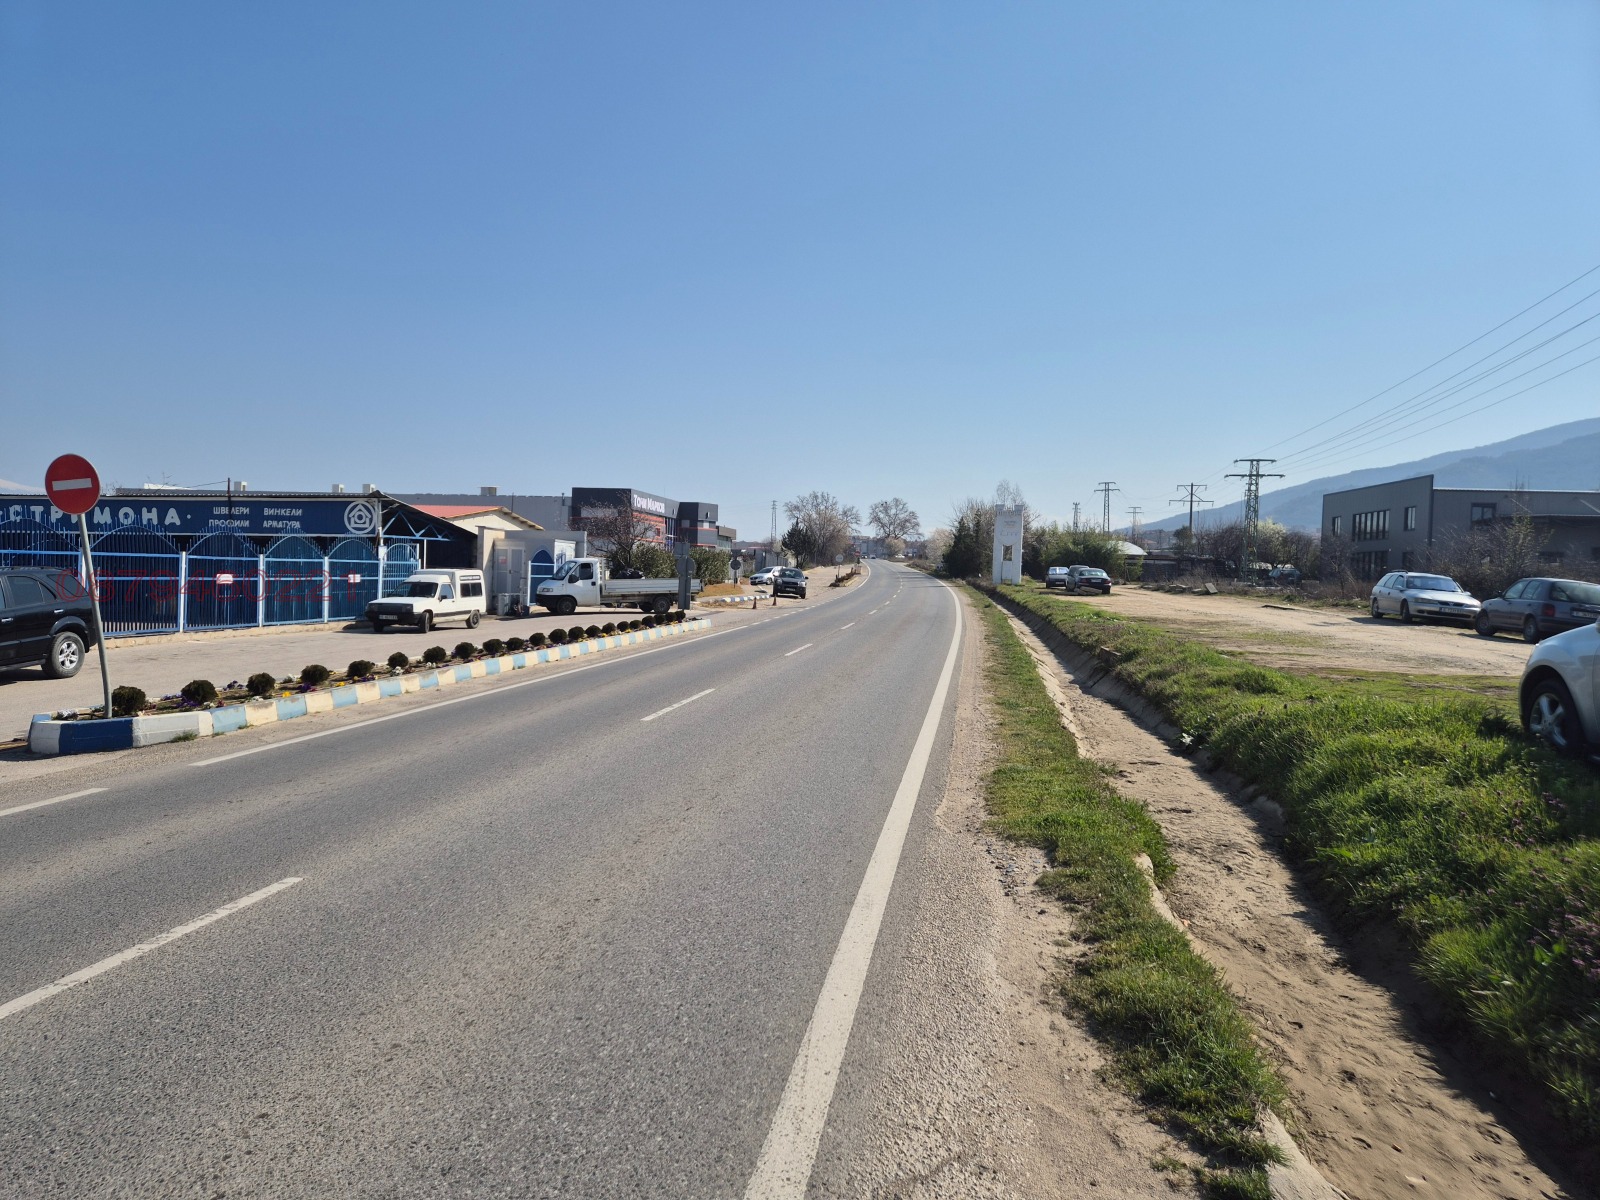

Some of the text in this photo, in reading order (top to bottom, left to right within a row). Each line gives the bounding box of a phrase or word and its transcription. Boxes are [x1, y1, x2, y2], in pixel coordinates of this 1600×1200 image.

[9, 504, 181, 526] СТРМОНА
[213, 506, 250, 515] ШВЕЛЕРИ
[263, 507, 303, 516] ВИНКЕЛИ
[208, 519, 250, 528] ПРОФИЛИ
[262, 520, 301, 529] АРМАТУРА
